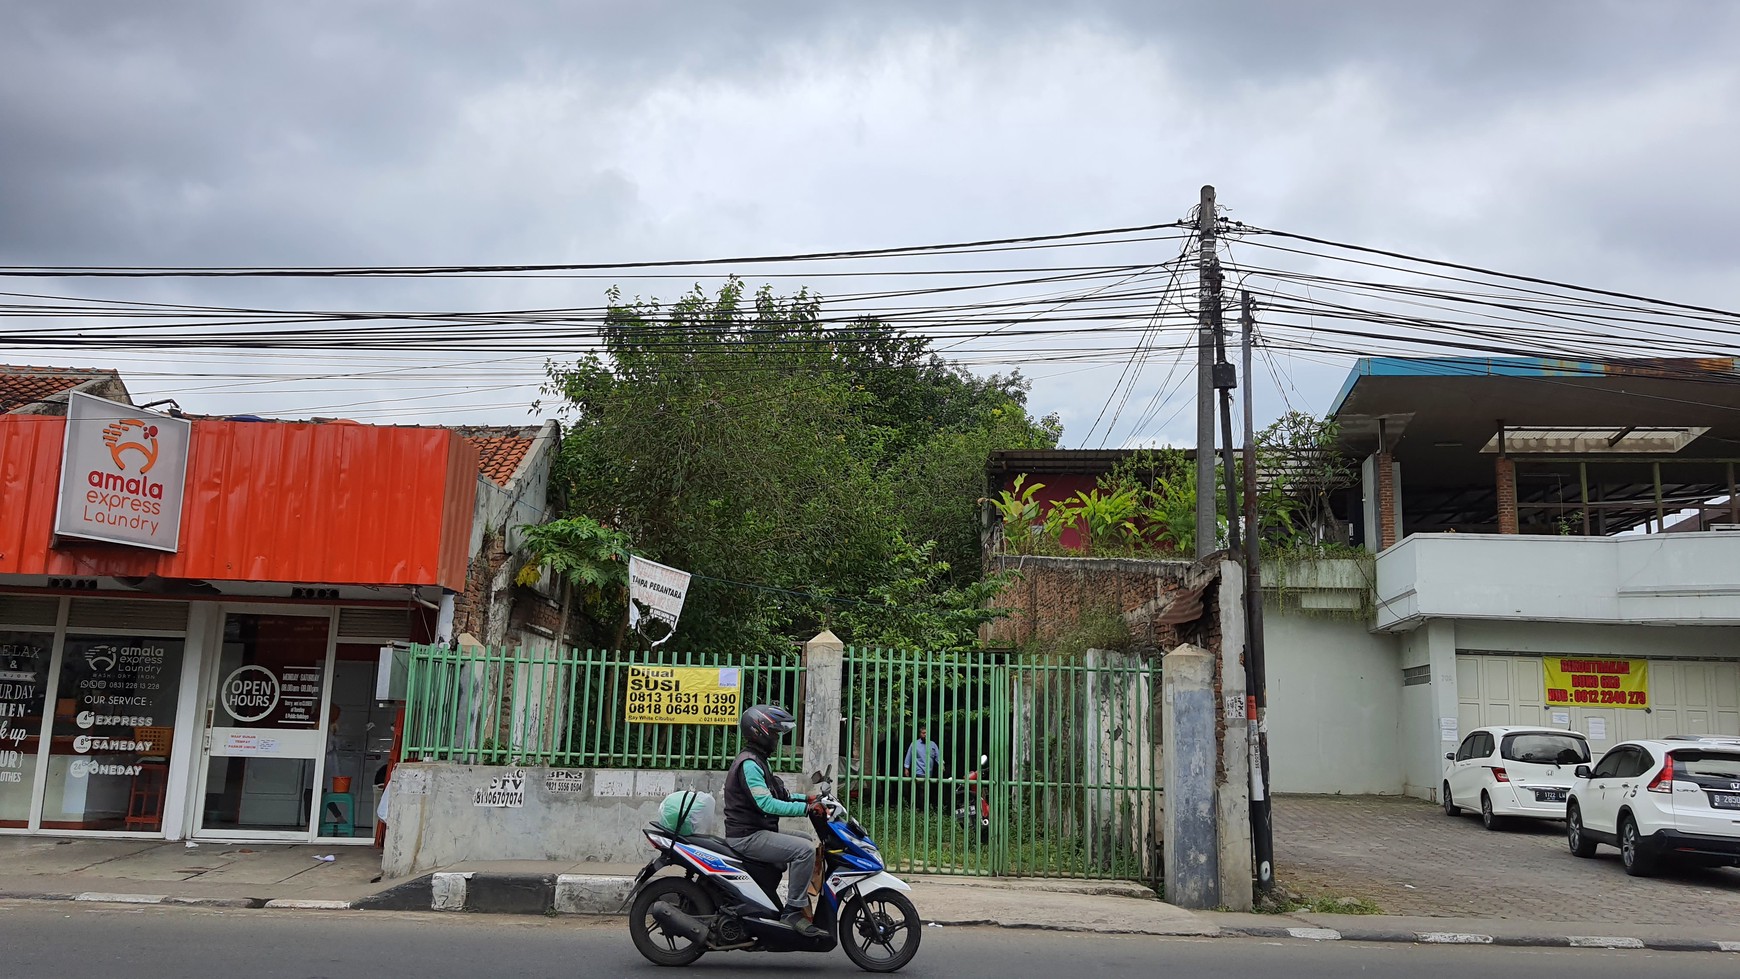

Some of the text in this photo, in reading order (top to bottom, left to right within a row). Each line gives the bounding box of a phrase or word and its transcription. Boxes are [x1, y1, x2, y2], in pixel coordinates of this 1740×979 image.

[88, 470, 163, 499] amala
[86, 490, 160, 515] express
[84, 505, 158, 536] Laundry
[648, 581, 682, 600] PERANTARA
[120, 646, 164, 656] amala
[10, 660, 17, 668] &
[120, 656, 163, 665] express
[118, 664, 162, 674] Laundry
[631, 668, 674, 679] Dijual
[231, 680, 272, 695] OPEN
[630, 679, 680, 692] SUSI
[1572, 674, 1599, 688] RUKO
[14, 684, 35, 700] DAY
[629, 692, 736, 704] 0813 1631 1390
[1548, 688, 1568, 702] HUB
[1574, 690, 1599, 703] 0812
[1600, 690, 1627, 704] 2340
[1628, 691, 1646, 704] 279
[84, 695, 105, 704] OUR
[108, 696, 146, 705] SERVICE
[229, 694, 270, 706] HOURS
[629, 703, 735, 716] 0818 0649 0492
[95, 715, 153, 726] EXPRESS
[9, 728, 27, 747] up
[92, 740, 153, 751] SAMEDAY
[89, 763, 142, 776] ONEDAY
